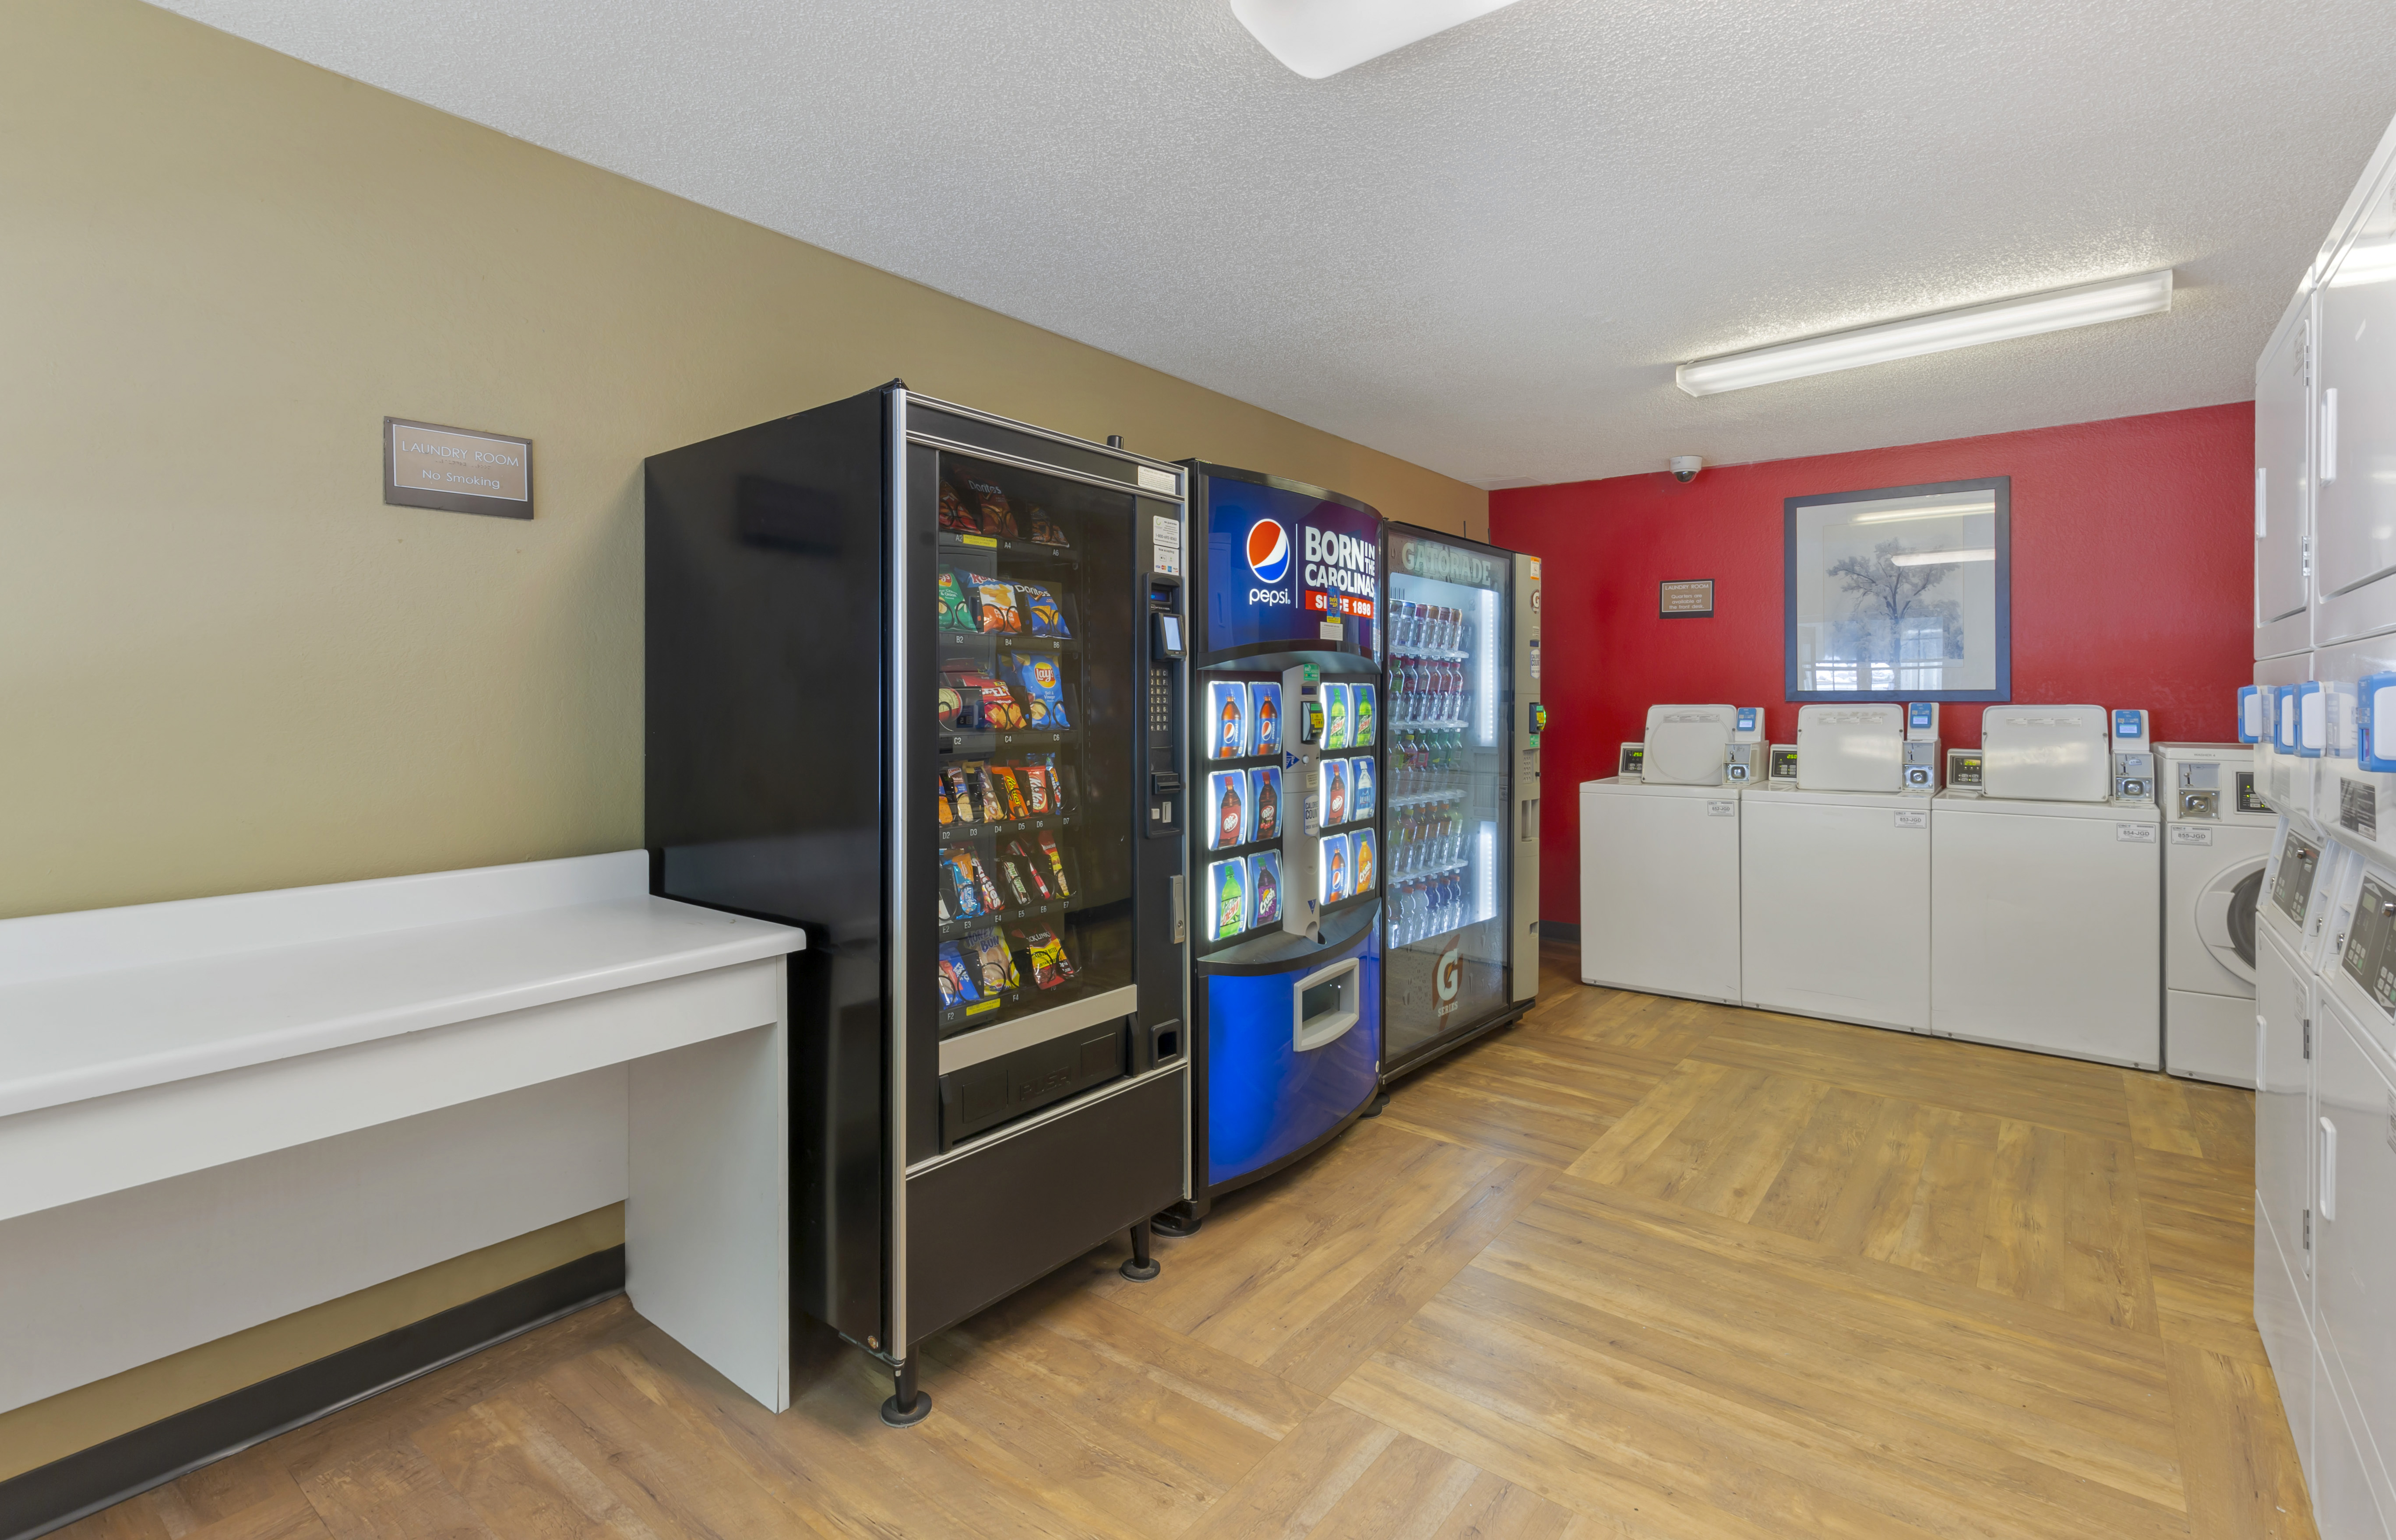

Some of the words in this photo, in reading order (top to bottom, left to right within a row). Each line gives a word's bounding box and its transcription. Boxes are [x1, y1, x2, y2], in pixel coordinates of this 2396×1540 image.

[402, 441, 468, 459] LAUNDRY
[475, 451, 519, 467] ROOM
[423, 469, 440, 480] No
[446, 472, 500, 489] Smoking
[968, 480, 1001, 494] Doritos
[1305, 526, 1365, 572] BORN
[1364, 542, 1375, 560] IN
[1364, 558, 1375, 577] THE
[1402, 542, 1491, 586] GATORADE
[1014, 584, 1051, 597] Doritos
[1305, 563, 1375, 598] CAROLINAS
[1249, 588, 1289, 606] pepsi
[1315, 594, 1349, 612] SIE
[1352, 601, 1371, 616] 1898
[1036, 668, 1055, 682] Lay's
[1005, 775, 1021, 805] Reese's
[1359, 861, 1371, 883] Crush
[1260, 887, 1275, 914] Crush
[980, 935, 999, 953] BUN
[1437, 948, 1459, 1001] G
[948, 1012, 955, 1020] F2
[1438, 1001, 1459, 1017] SERIES
[1019, 1066, 1071, 1101] PUSH
